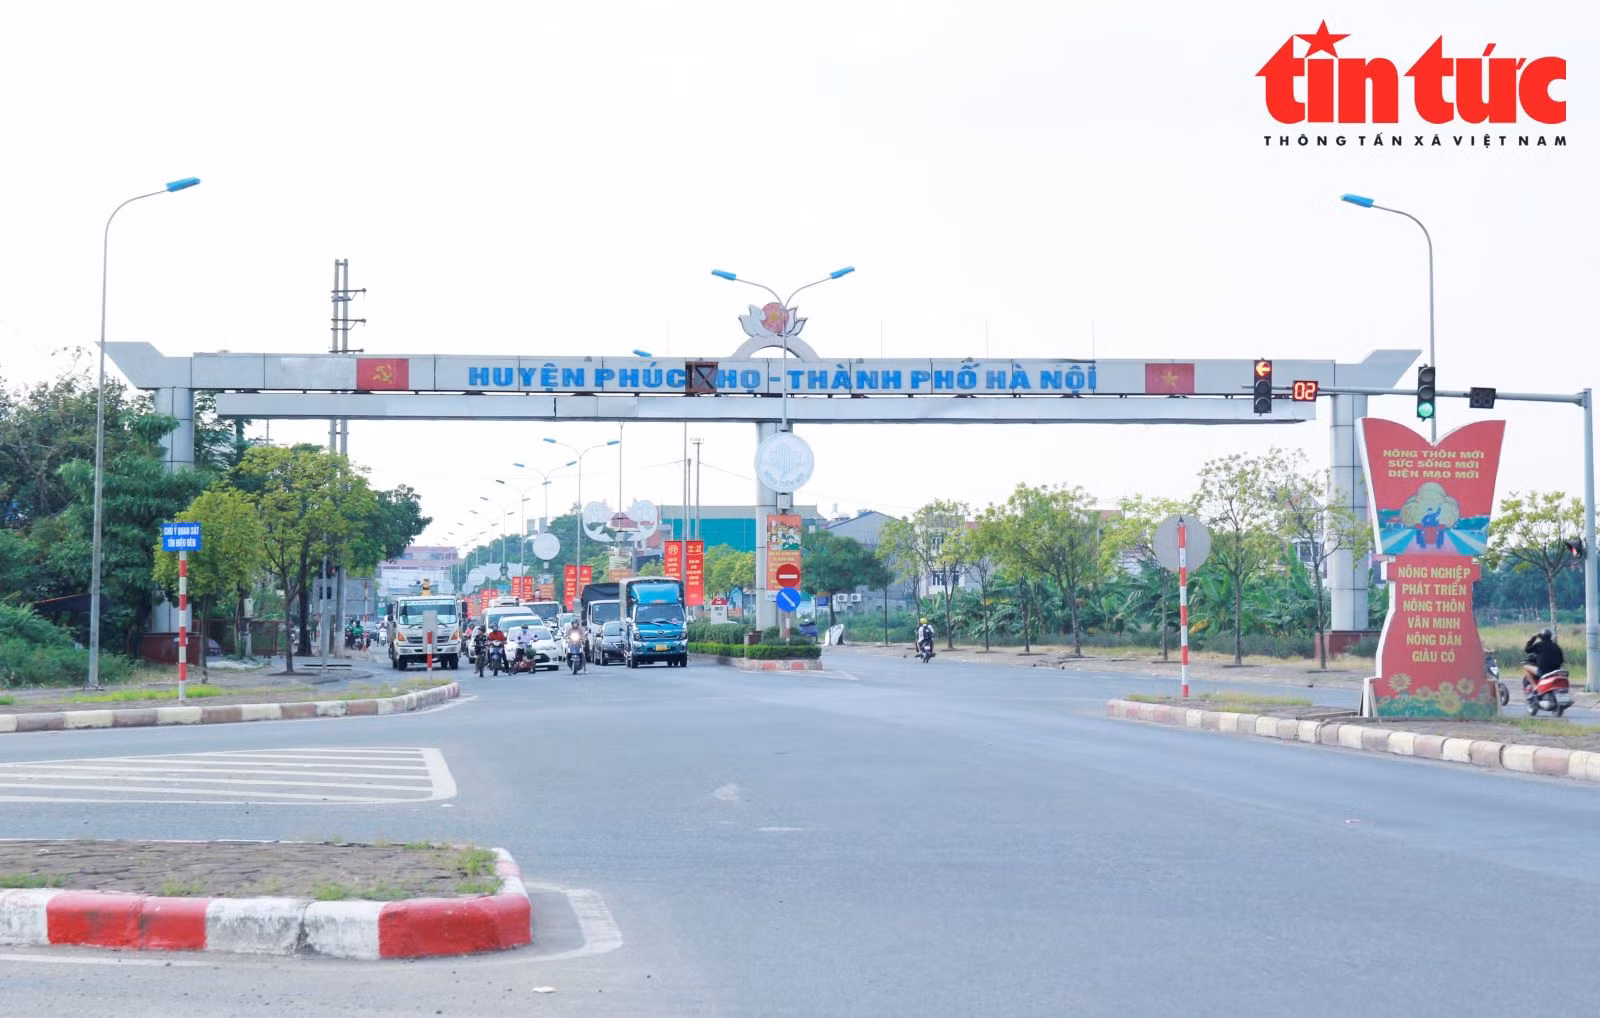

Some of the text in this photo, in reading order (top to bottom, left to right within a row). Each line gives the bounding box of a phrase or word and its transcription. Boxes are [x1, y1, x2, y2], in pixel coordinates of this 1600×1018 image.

[468, 362, 585, 391] HUYỆN
[595, 362, 688, 388] PHÚC
[787, 364, 902, 390] THÀNH
[911, 362, 980, 390] PHỐ
[986, 363, 1031, 390] HÀ
[1040, 365, 1097, 395] NỘI
[1294, 382, 1316, 400] 02
[1383, 448, 1485, 459] NÔNG THÔN MỚI
[1388, 458, 1479, 469] SỨC SỐNG MỚI
[1388, 468, 1479, 480] DIỆN MẠO MỚI
[1398, 564, 1471, 581] NÔNG NGHIỆP
[1402, 577, 1467, 596] PHÁT TRIỂN
[1403, 597, 1466, 613] NÔNG THÔN
[1407, 615, 1460, 630] VĂN MINH
[1407, 631, 1462, 646] NÔNG DÂN
[1440, 648, 1456, 663] CÓ
